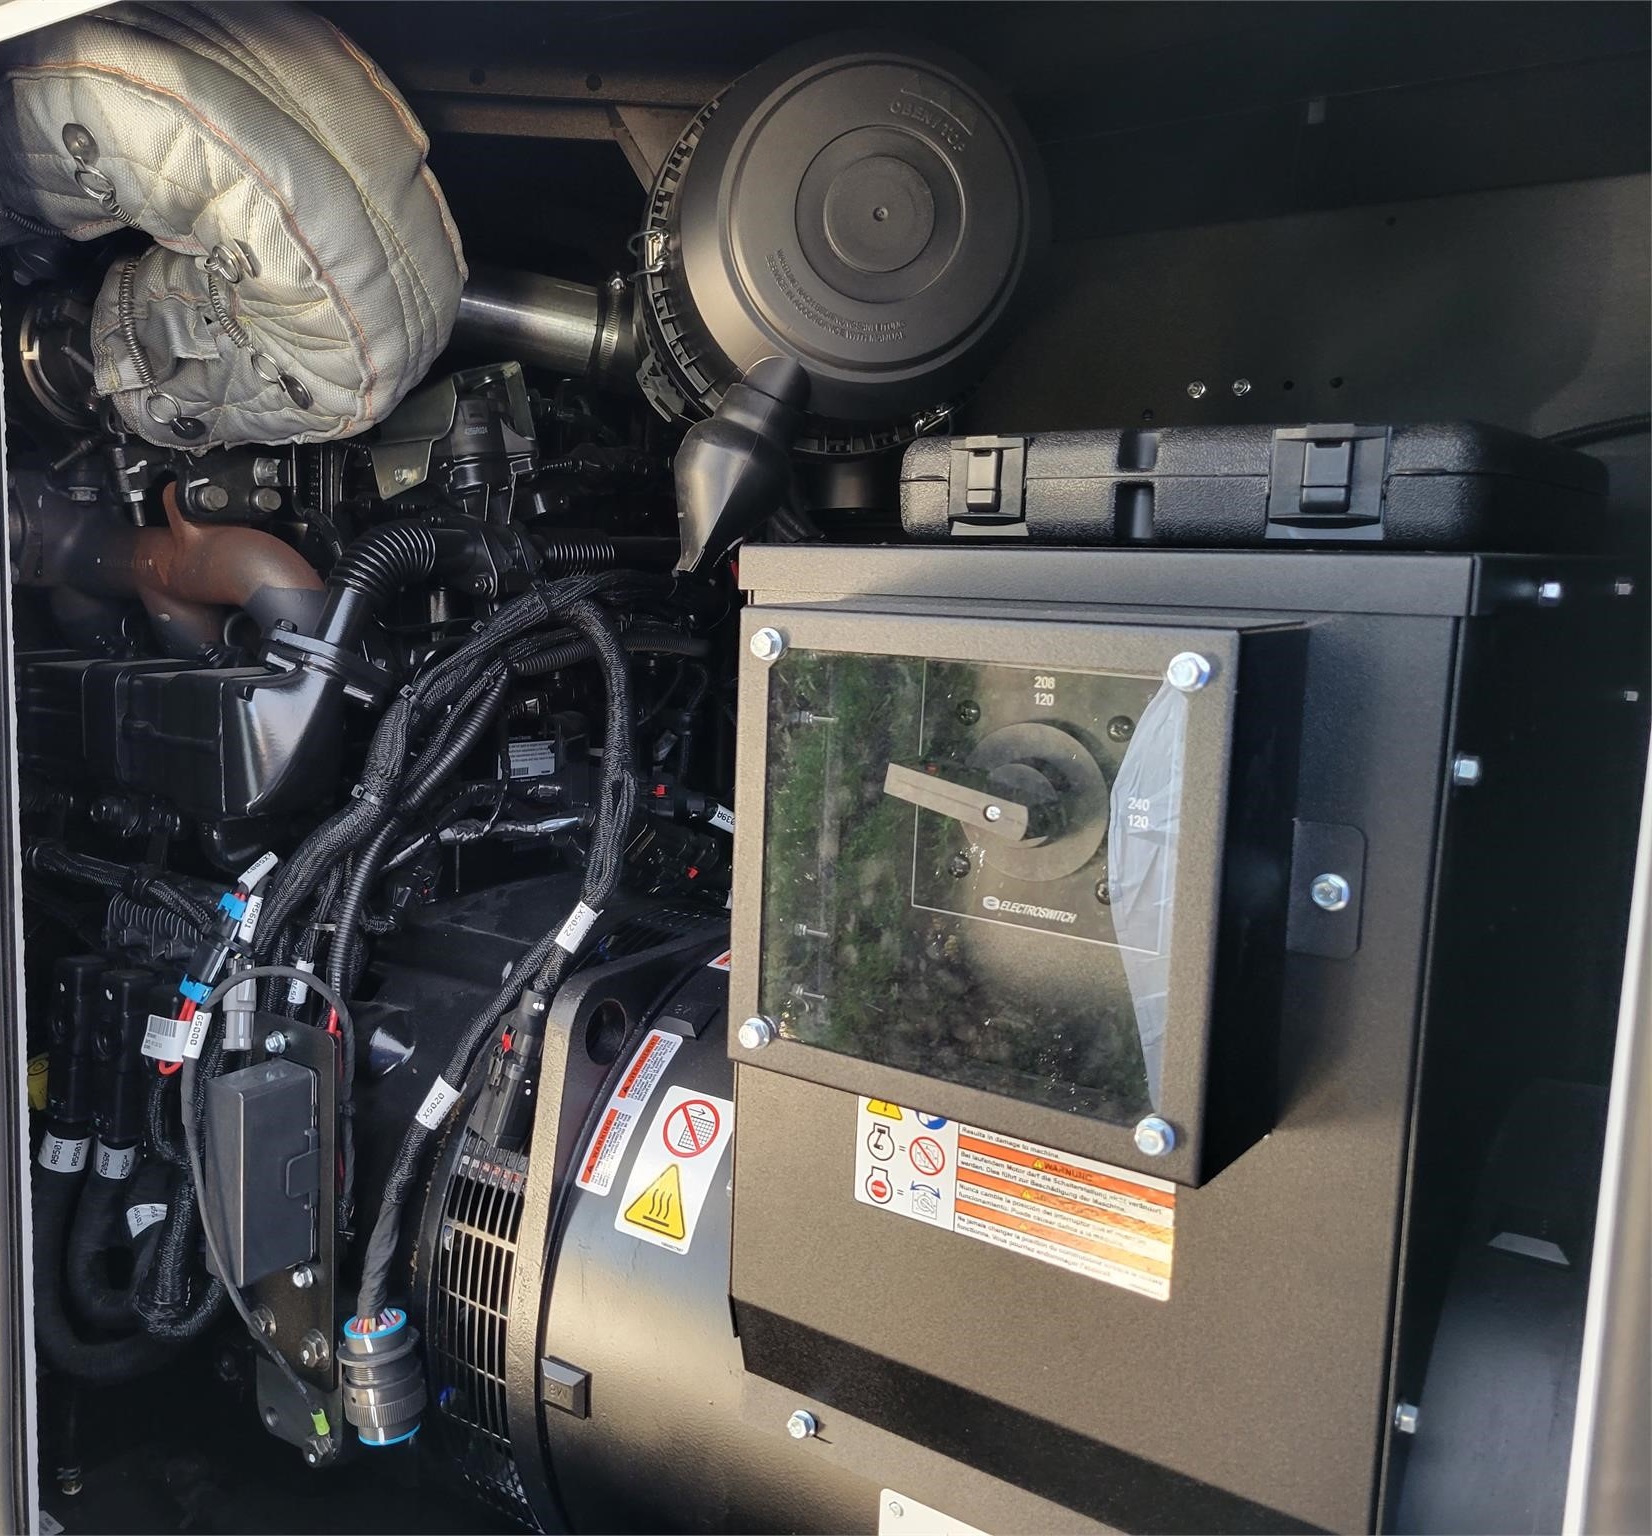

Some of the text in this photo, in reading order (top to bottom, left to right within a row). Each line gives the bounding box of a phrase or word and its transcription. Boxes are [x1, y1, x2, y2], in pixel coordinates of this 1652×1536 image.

[1034, 675, 1055, 690] 208
[1034, 691, 1055, 706] 120
[1127, 796, 1150, 811] 240
[1127, 814, 1149, 829] 120
[244, 902, 261, 929] R5601
[1000, 900, 1078, 924] ELECTROSWITCH
[190, 1014, 204, 1046] G5000
[423, 1092, 445, 1119] X5020
[592, 1120, 612, 1158] WARNING
[961, 1126, 985, 1138] Results
[994, 1135, 1020, 1149] damage
[50, 1140, 64, 1165] A5501
[71, 1141, 84, 1167] A5501
[100, 1152, 111, 1176] A5502
